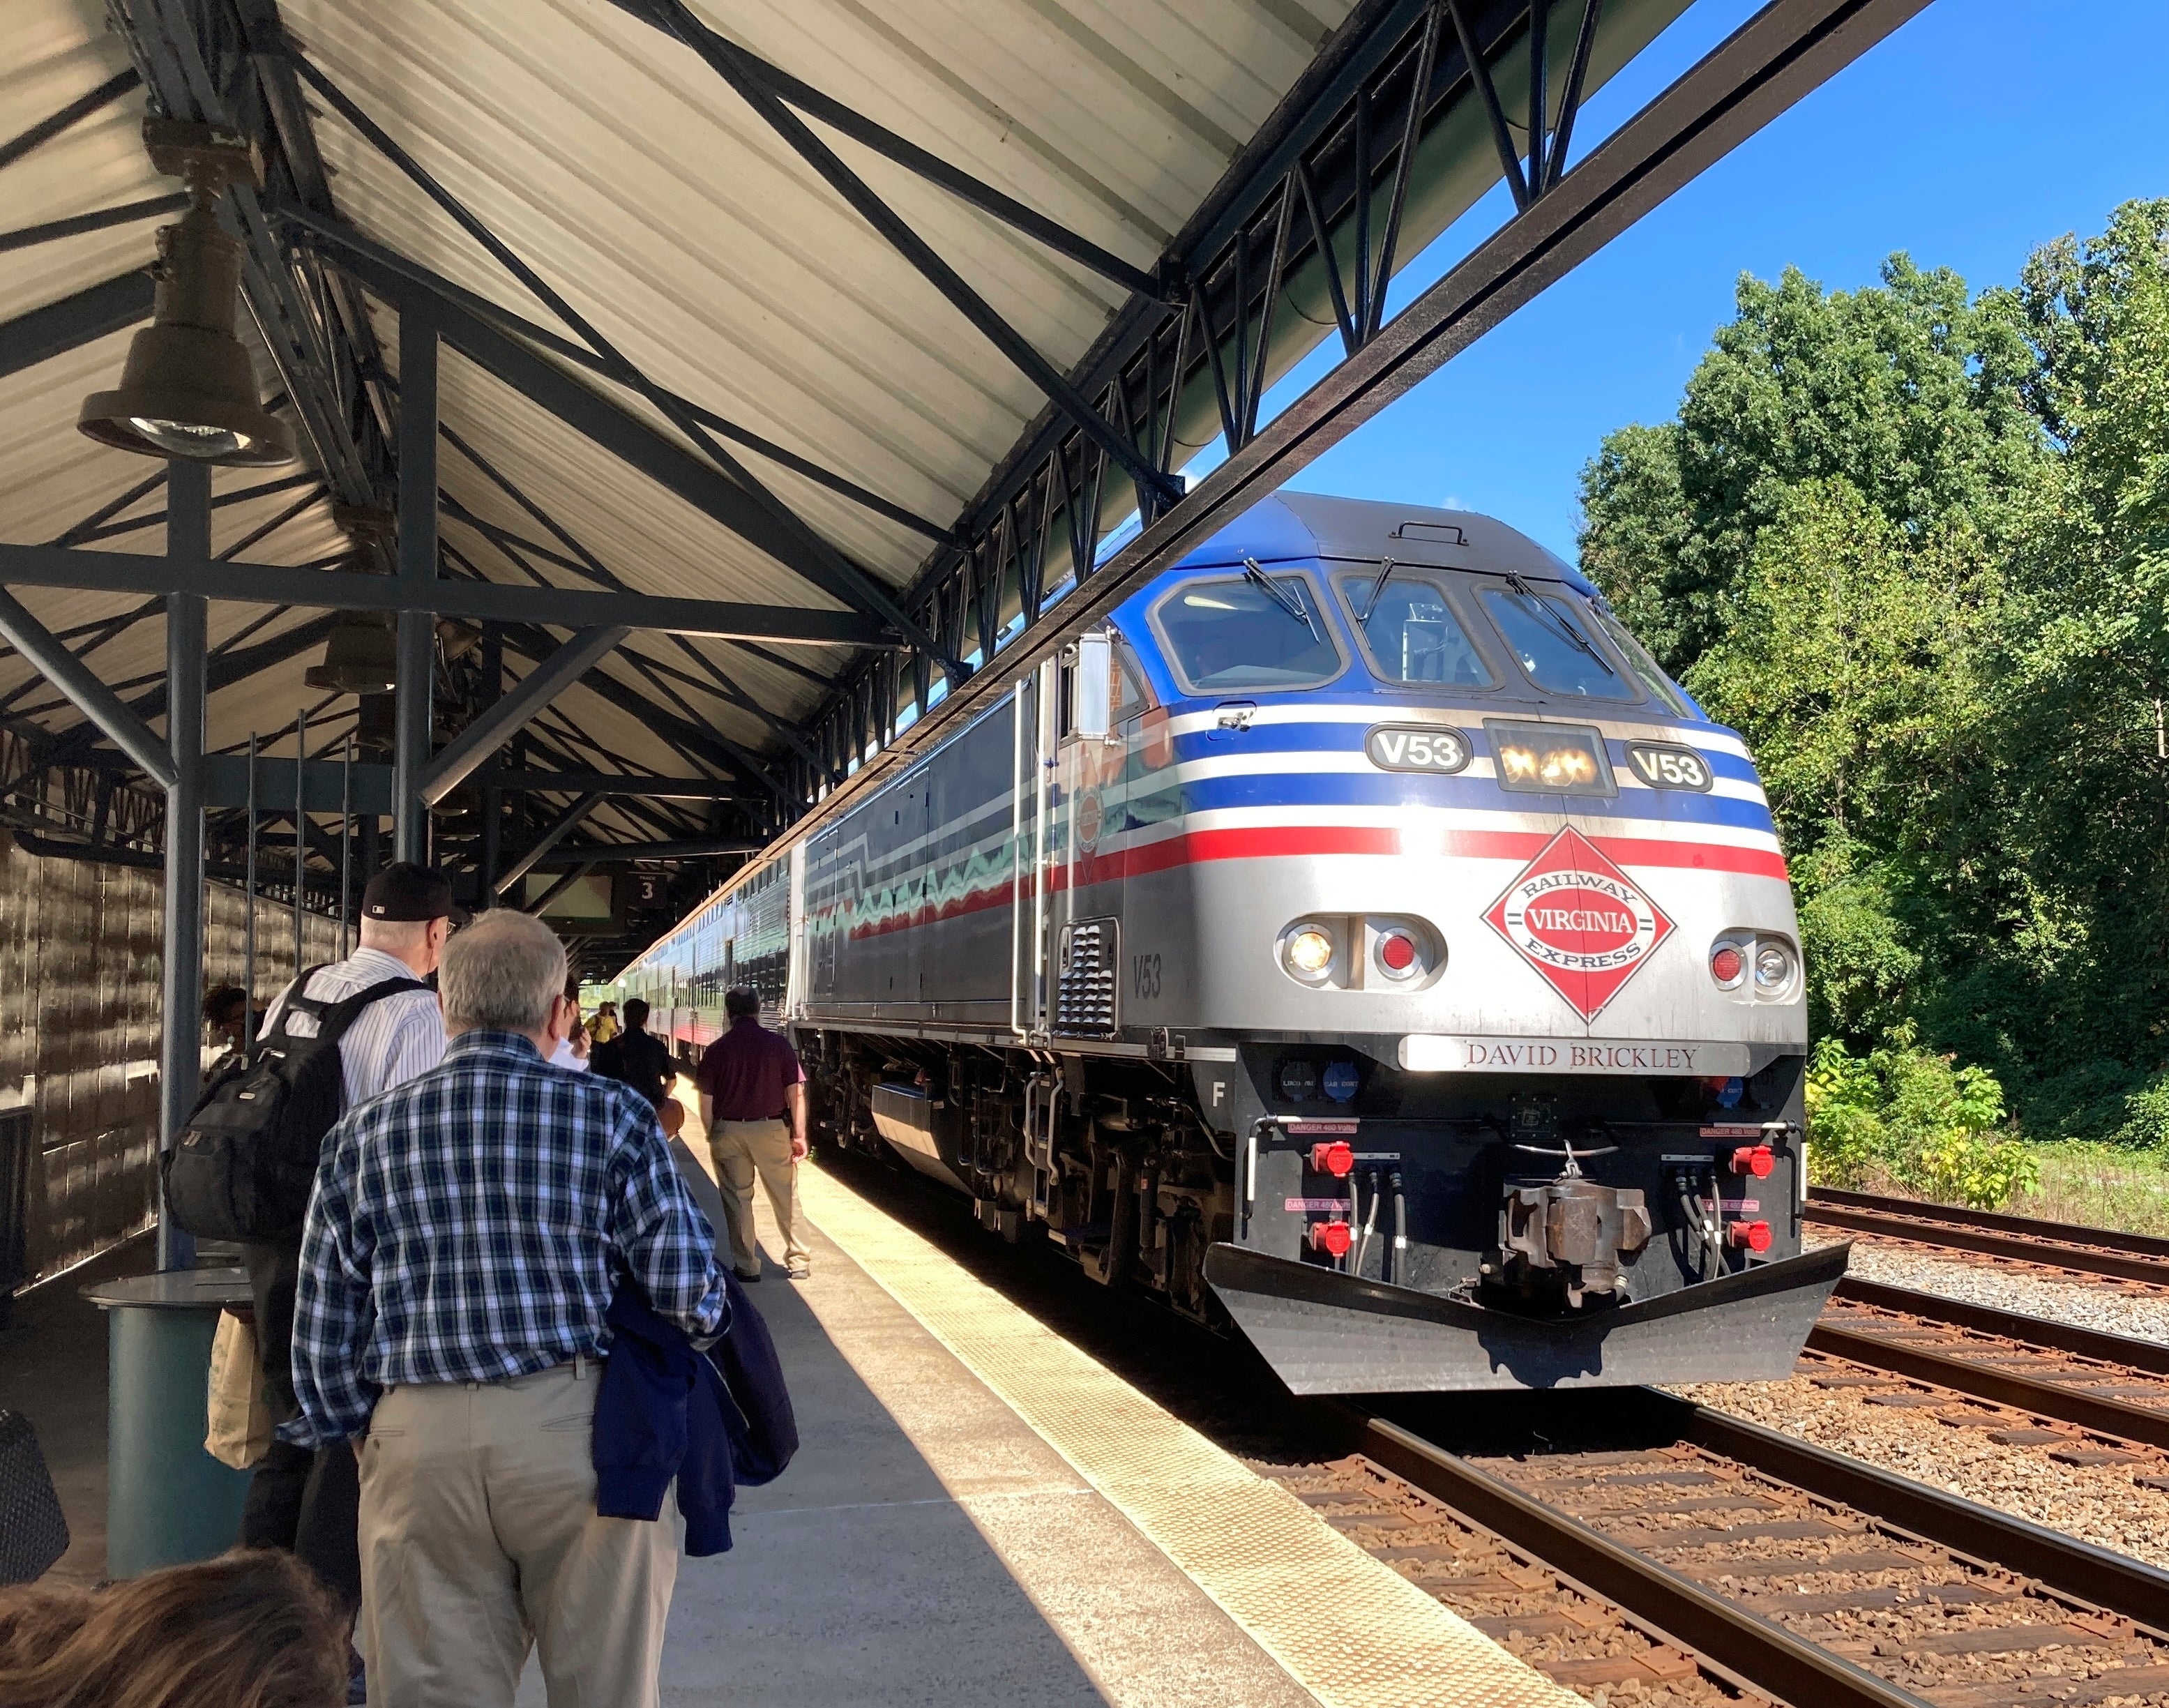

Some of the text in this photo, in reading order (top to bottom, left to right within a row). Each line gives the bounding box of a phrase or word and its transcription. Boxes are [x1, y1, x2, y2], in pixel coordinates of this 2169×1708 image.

[1377, 734, 1458, 766] V53
[1632, 750, 1704, 786] V53
[642, 882, 653, 899] 3
[1520, 874, 1638, 903] RAILWAY
[1527, 908, 1634, 934] VIRGINIA
[1525, 938, 1641, 967] EXPRESS
[1133, 953, 1161, 999] V53
[1467, 1044, 1696, 1069] DAVID BRICKLEY
[1212, 1082, 1225, 1107] F
